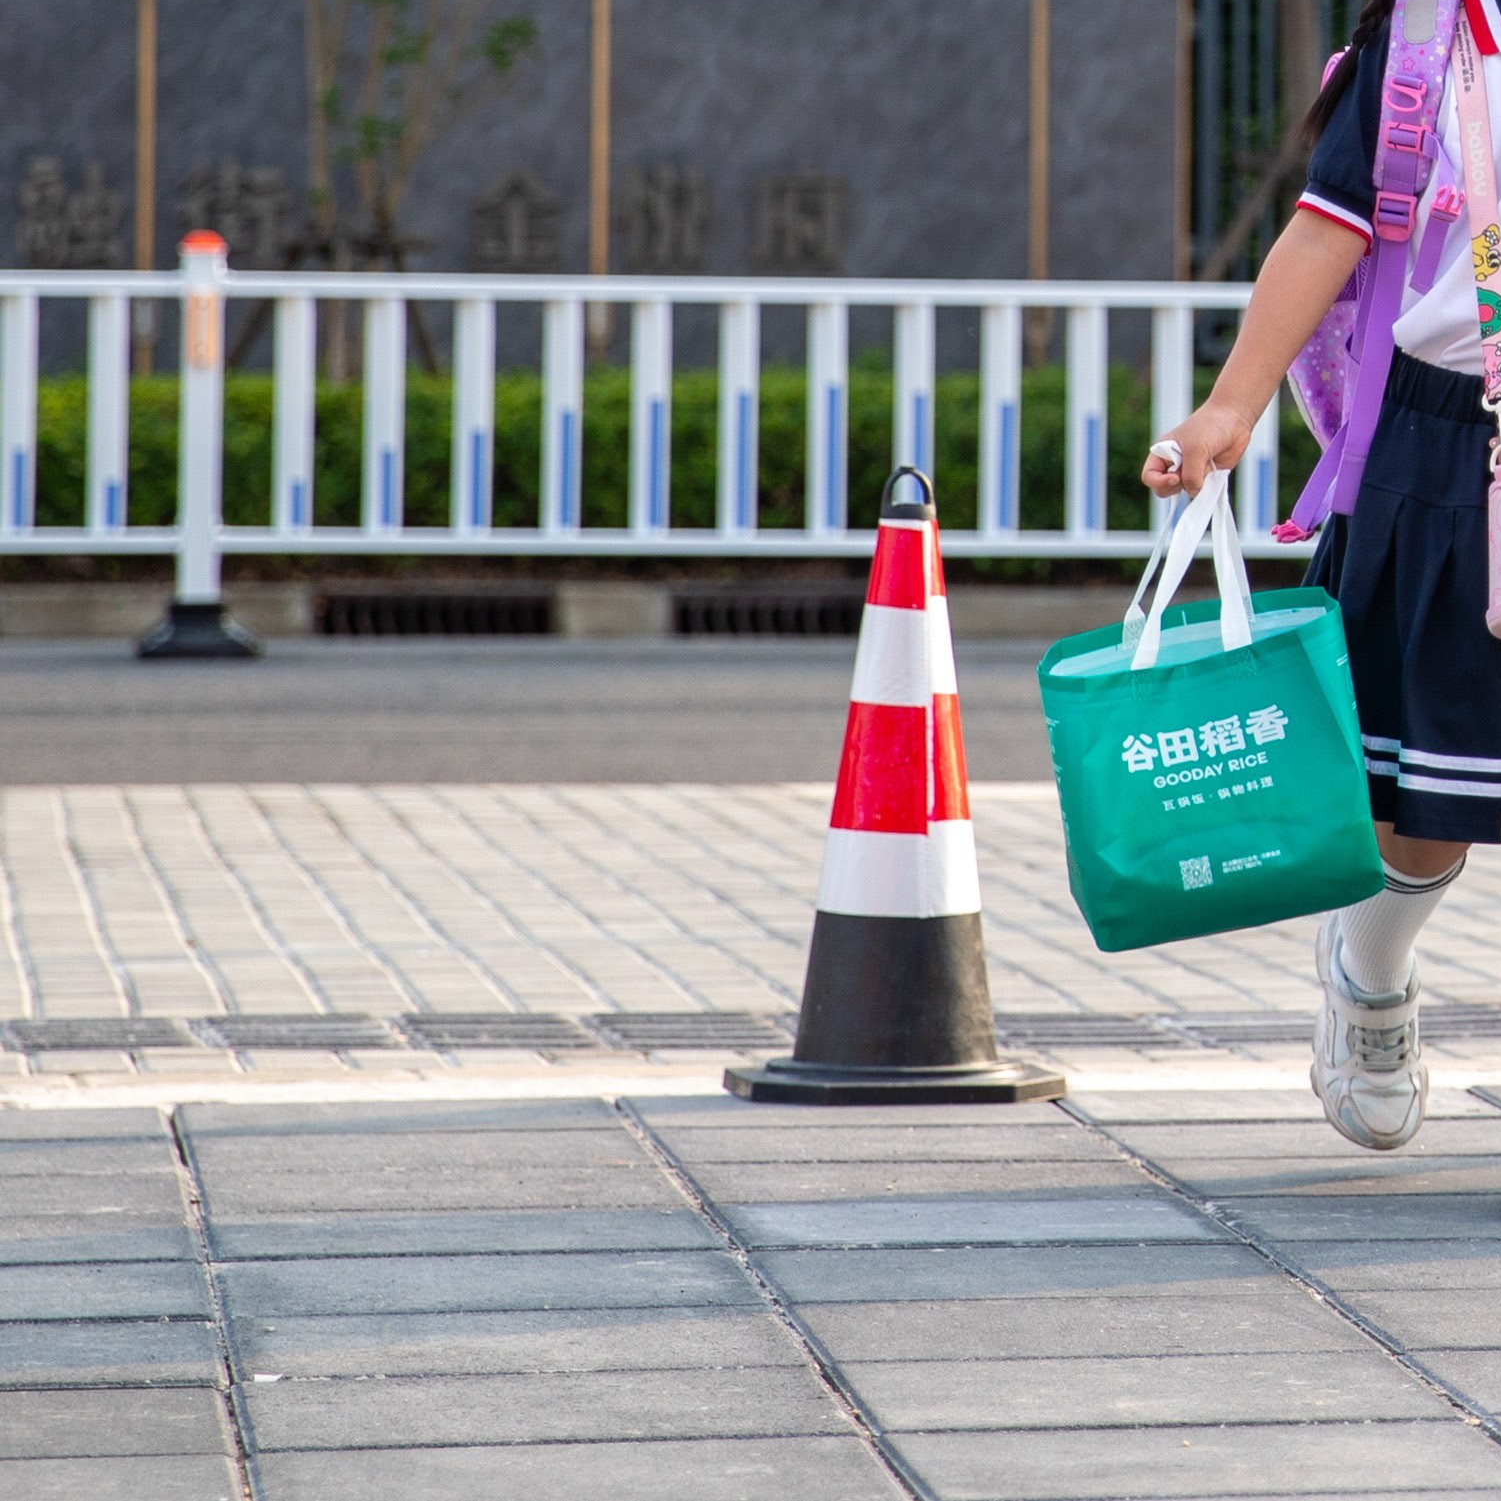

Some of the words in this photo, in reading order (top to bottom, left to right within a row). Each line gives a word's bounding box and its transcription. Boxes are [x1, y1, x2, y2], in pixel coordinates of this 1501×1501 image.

[1121, 703, 1289, 773] 谷田稻香
[1153, 762, 1224, 789] GOODAY
[1228, 751, 1268, 772] RICE
